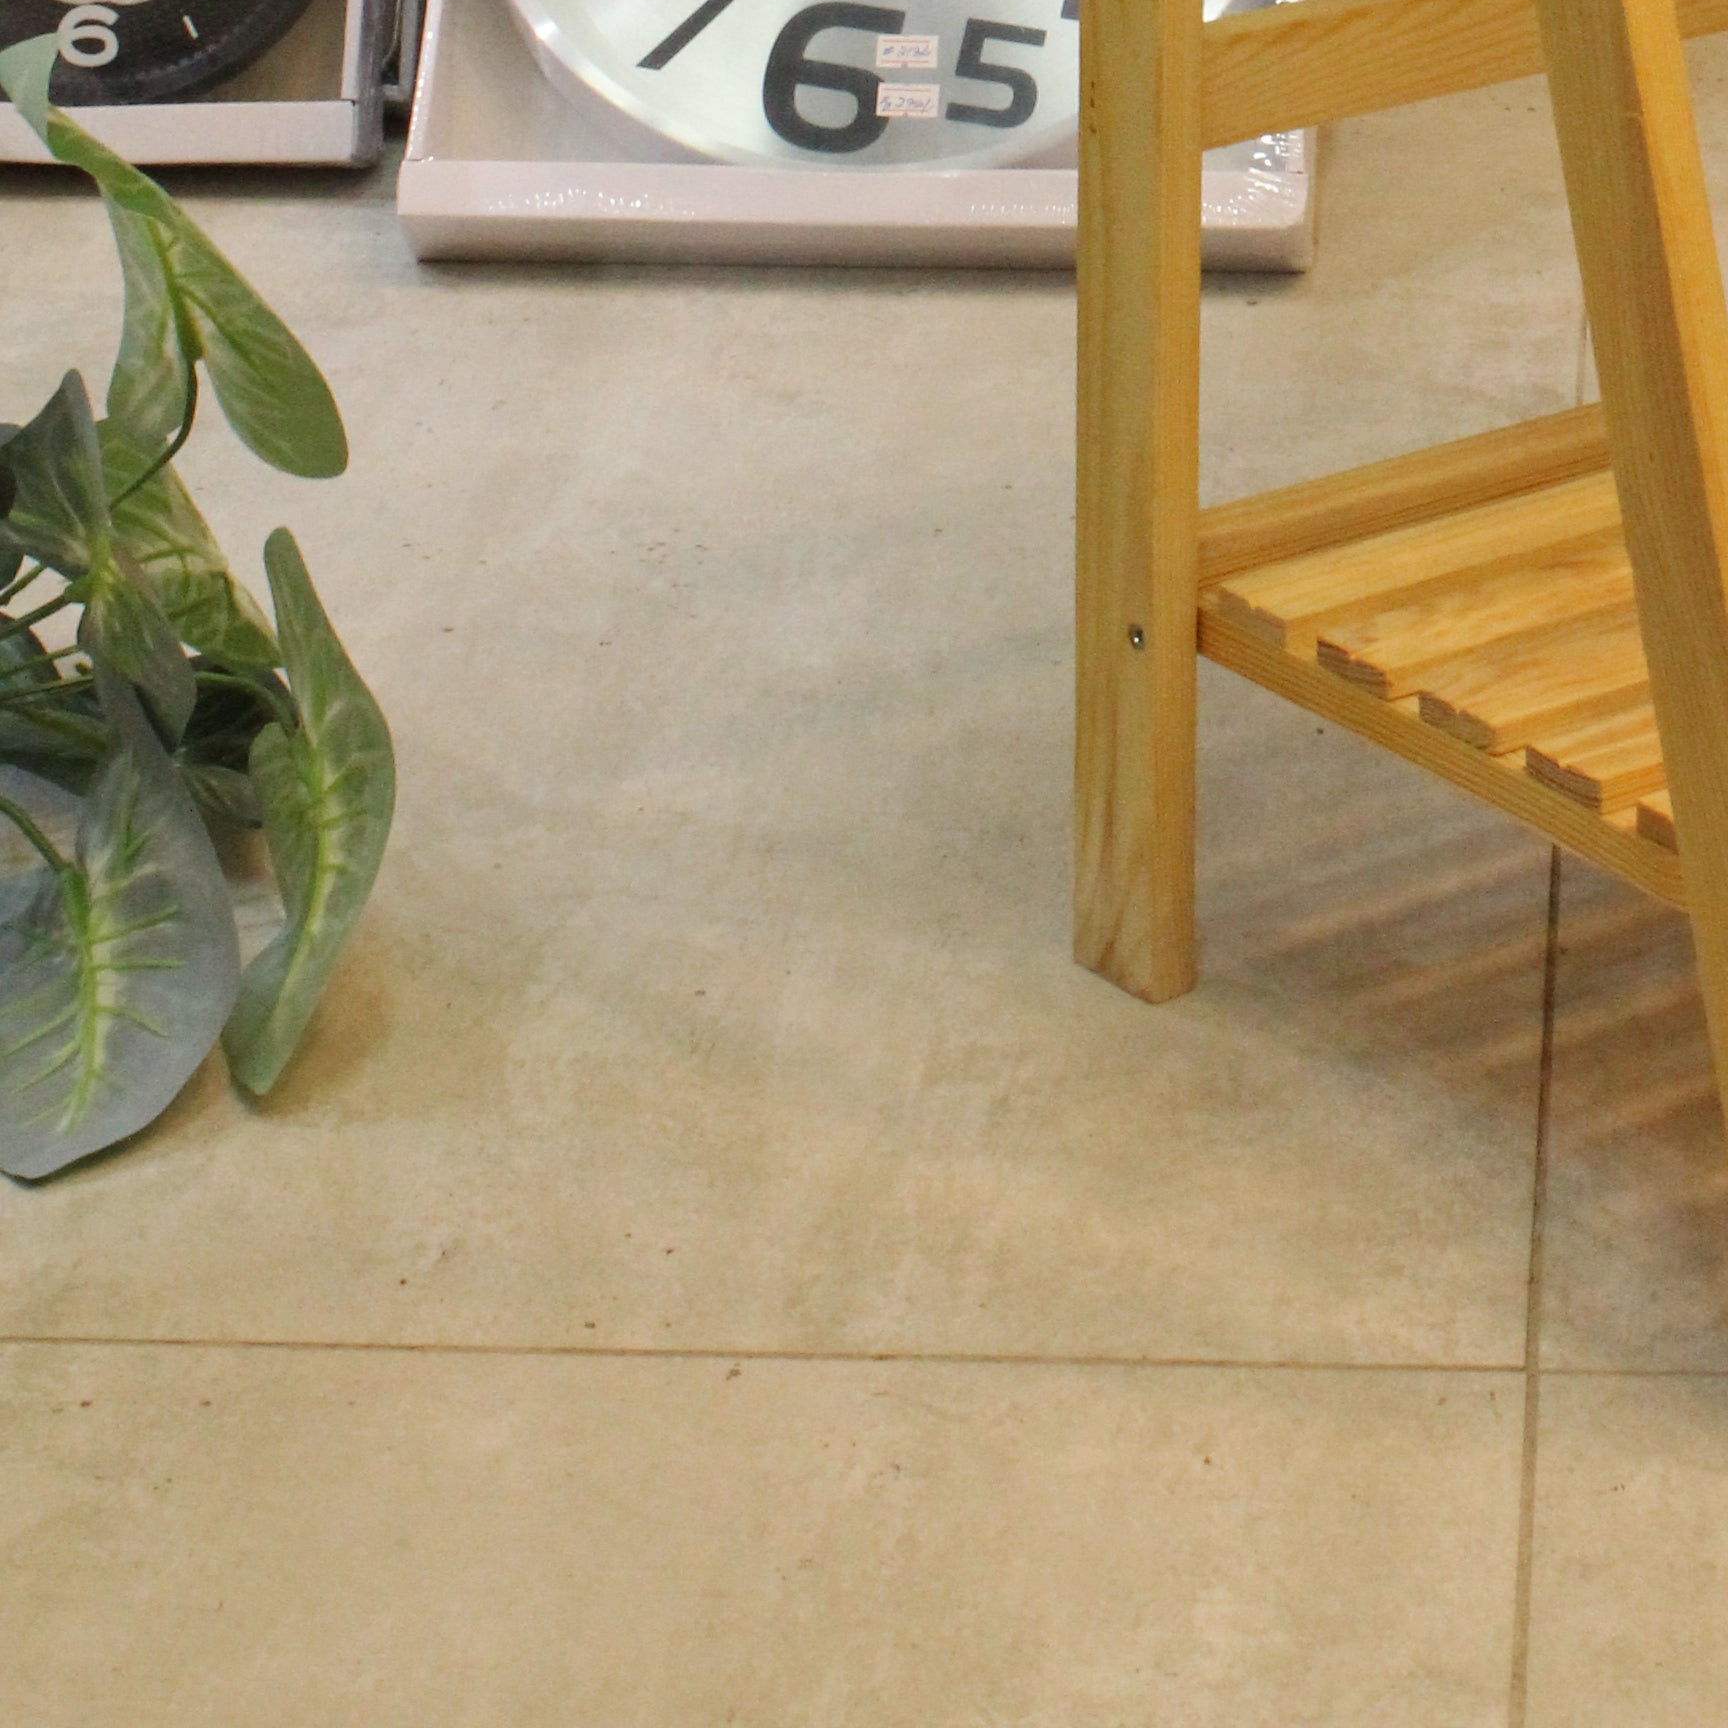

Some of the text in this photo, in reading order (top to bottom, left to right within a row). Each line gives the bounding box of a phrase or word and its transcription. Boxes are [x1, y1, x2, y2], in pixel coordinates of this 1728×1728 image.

[57, 4, 119, 68] 6
[761, 0, 907, 153] 6
[946, 17, 1048, 130] 5
